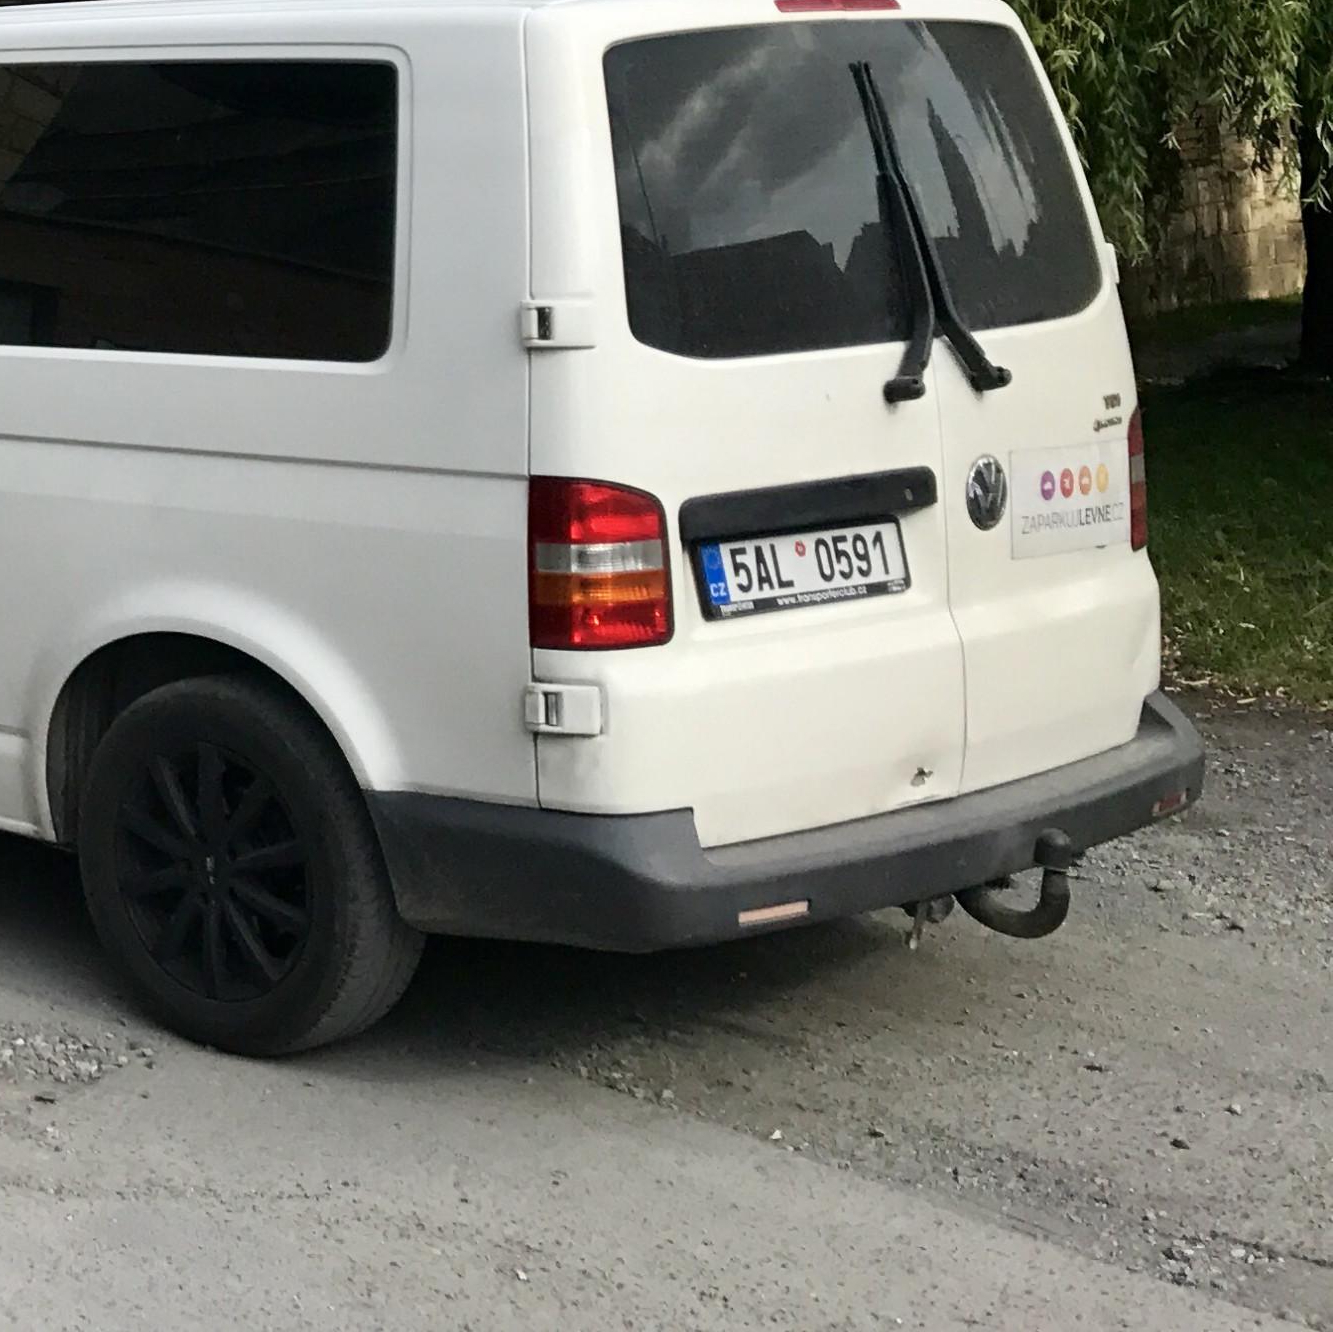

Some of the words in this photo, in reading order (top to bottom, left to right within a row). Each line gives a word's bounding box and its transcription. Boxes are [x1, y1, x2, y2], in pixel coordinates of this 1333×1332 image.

[729, 543, 795, 594] 5AL
[814, 530, 890, 582] 0591
[709, 582, 728, 598] CZ
